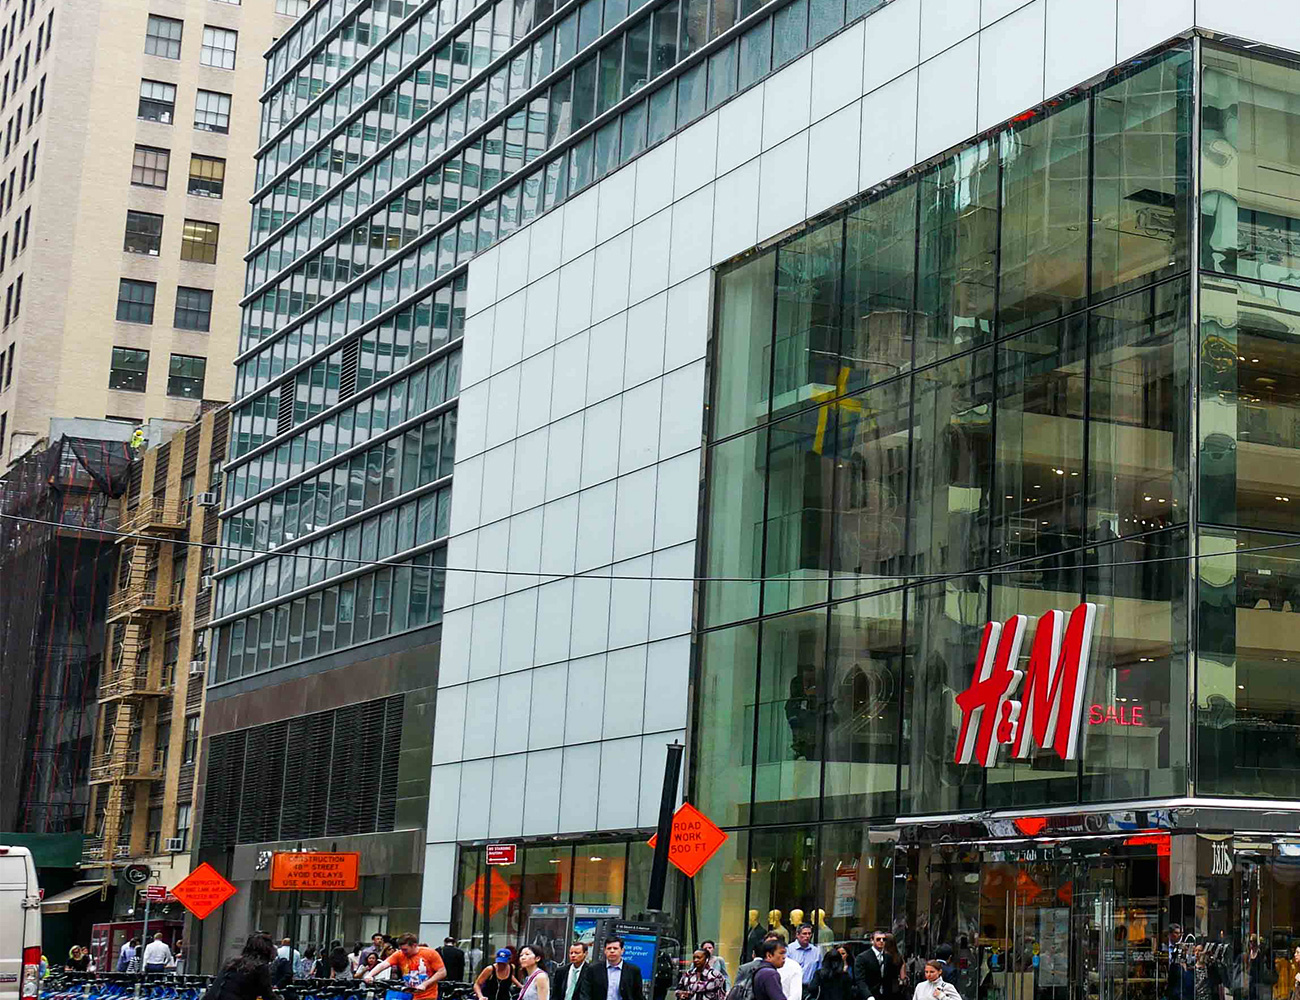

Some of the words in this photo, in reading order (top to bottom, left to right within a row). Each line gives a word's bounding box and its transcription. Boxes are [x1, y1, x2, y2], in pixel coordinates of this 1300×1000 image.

[955, 602, 1097, 768] H&M
[1088, 704, 1145, 726] SALE
[674, 821, 702, 831] ROAD
[675, 832, 702, 841] WORK
[671, 844, 691, 854] 500
[695, 843, 706, 852] FT
